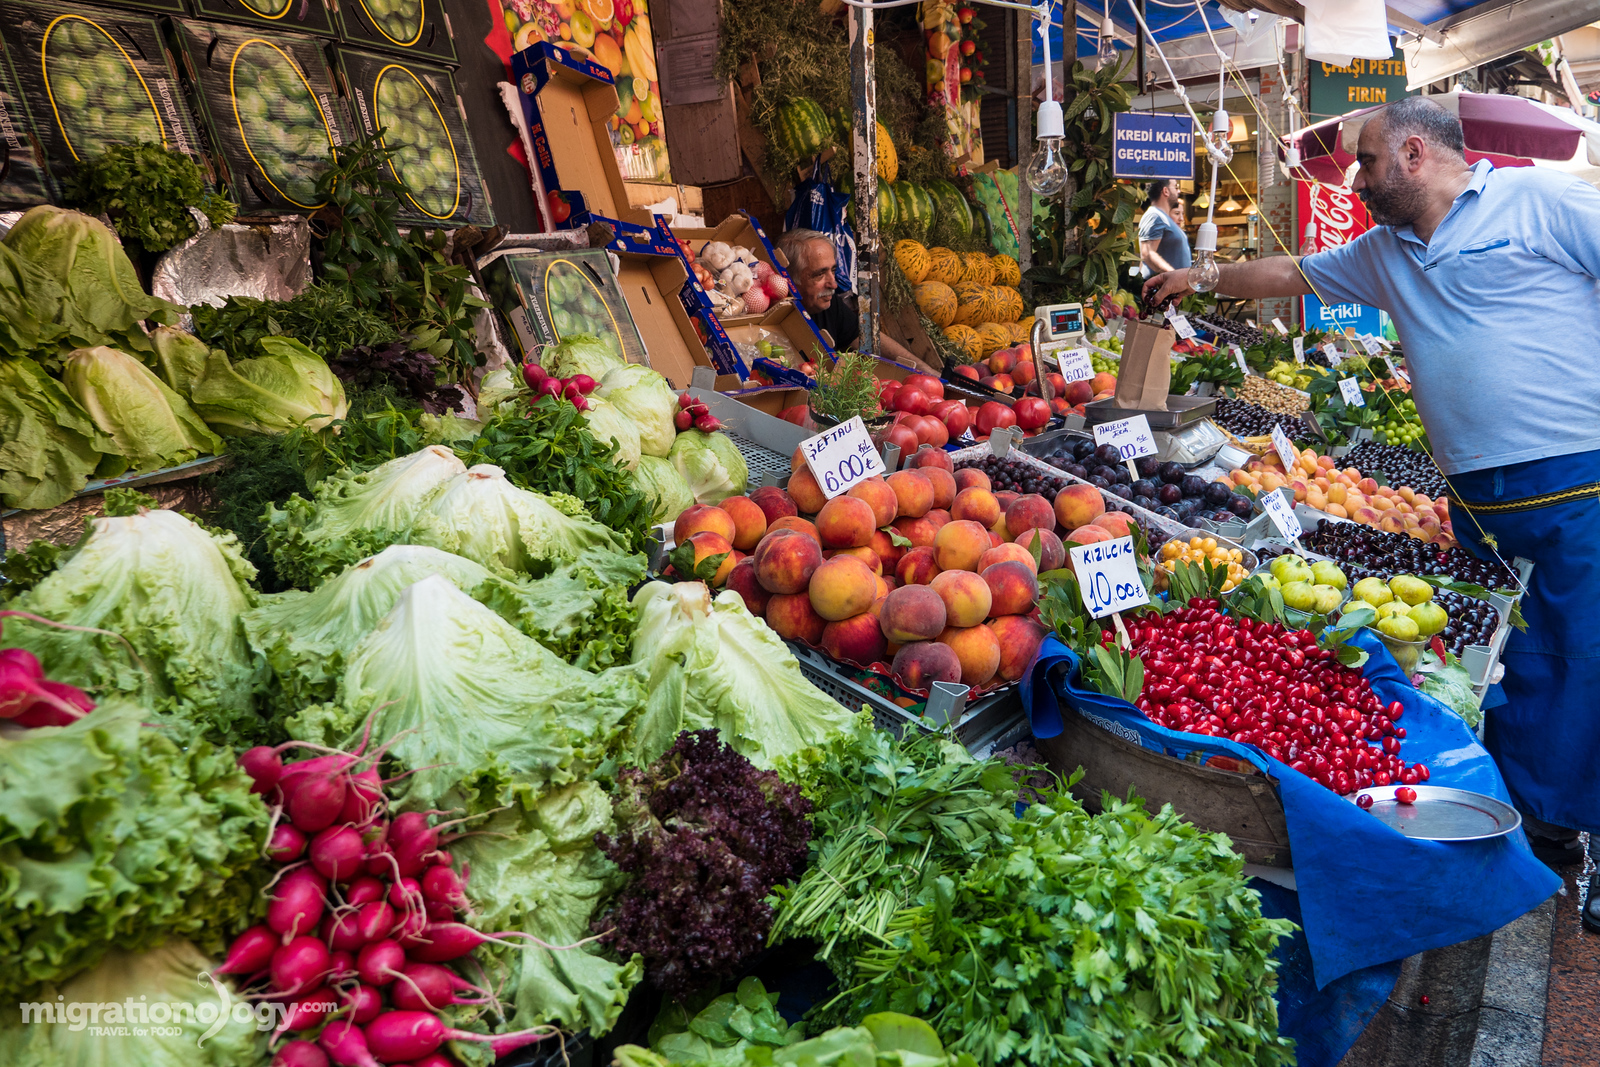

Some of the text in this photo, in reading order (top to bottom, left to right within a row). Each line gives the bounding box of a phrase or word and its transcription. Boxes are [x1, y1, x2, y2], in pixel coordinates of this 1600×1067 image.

[1347, 86, 1387, 103] FIRIN
[1117, 128, 1191, 144] KREDİ KARTI
[1117, 148, 1190, 163] GEÇERLİDİR.
[1320, 303, 1362, 320] Erikli
